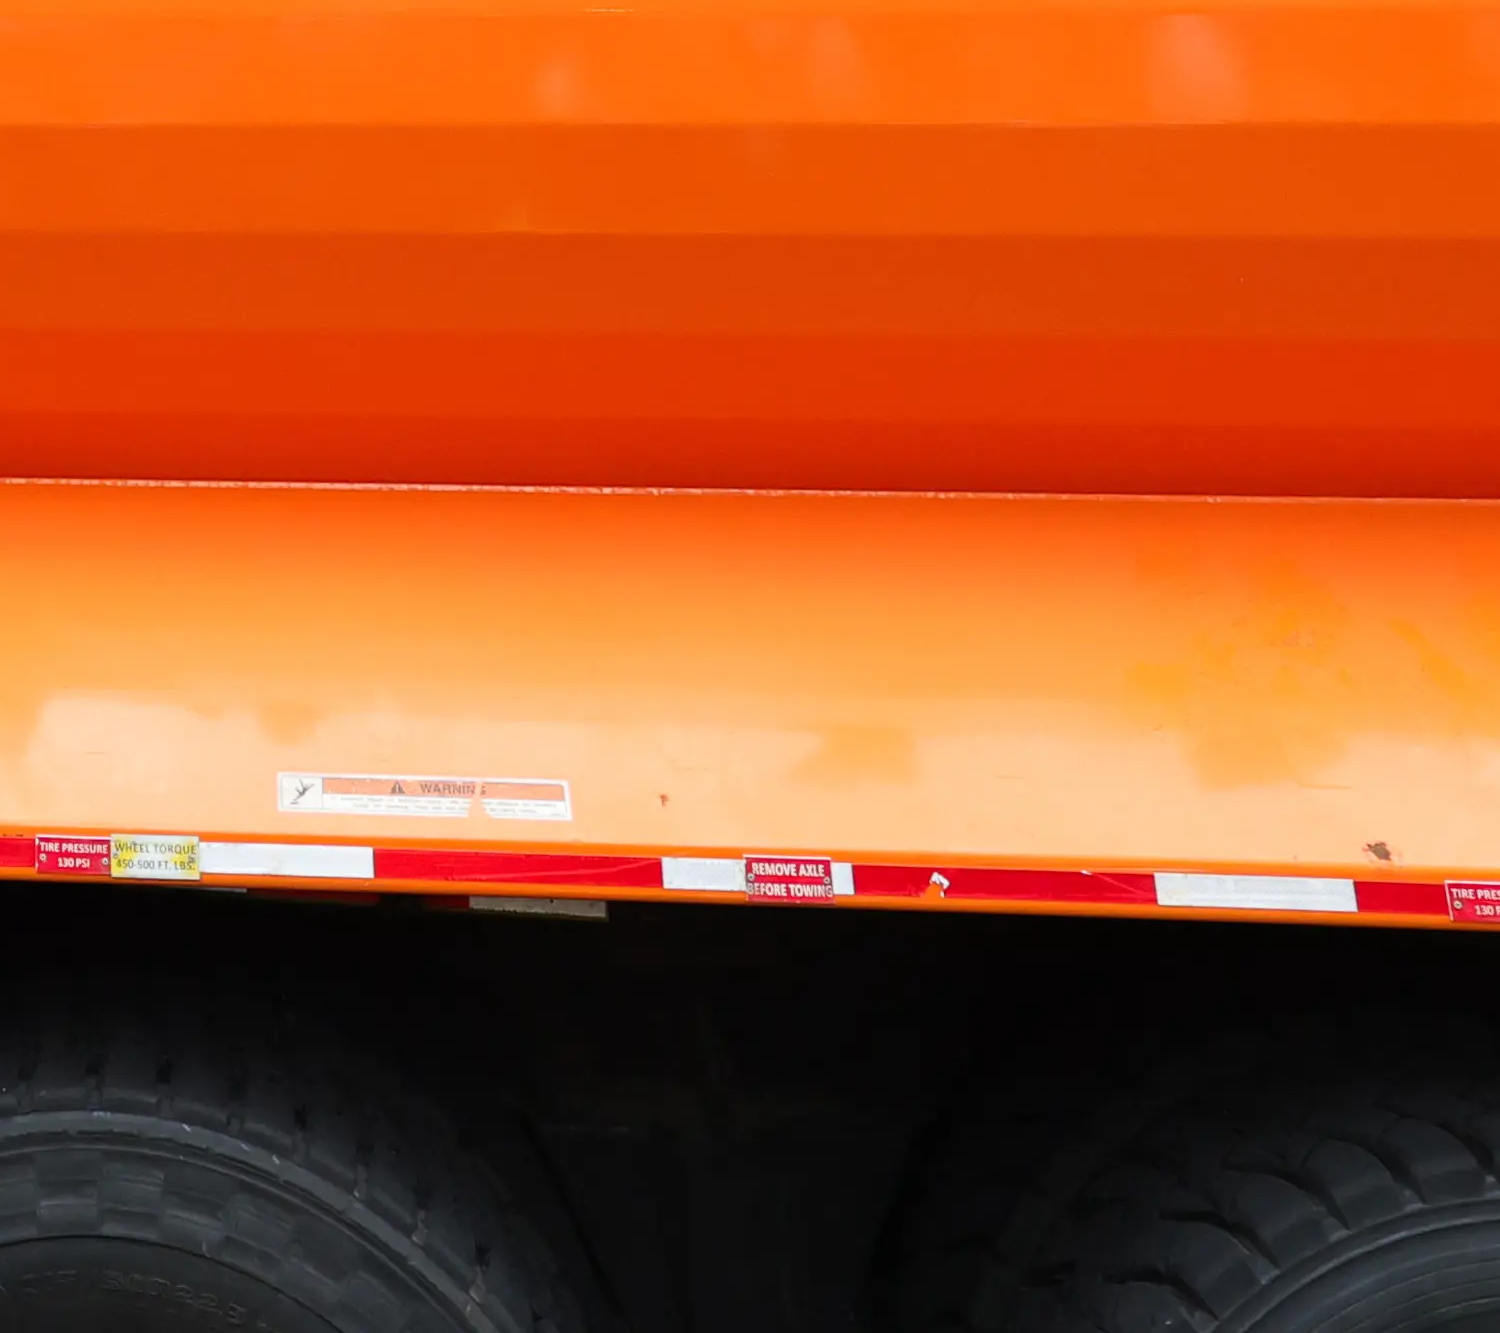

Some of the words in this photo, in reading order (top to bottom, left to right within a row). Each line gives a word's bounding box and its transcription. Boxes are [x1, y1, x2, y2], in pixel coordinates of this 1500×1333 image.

[40, 842, 59, 854] TIRE
[62, 842, 108, 854] PRESSURE
[115, 842, 150, 854] WHEEL
[154, 842, 197, 854] TORQUE
[58, 857, 75, 868] 130
[76, 857, 90, 868] PSI
[752, 862, 797, 877] REMOVE
[799, 862, 824, 877] AXLE
[748, 883, 787, 897] BEFORE
[789, 883, 832, 897] TOWING
[1451, 888, 1475, 901] TIRE
[1474, 905, 1494, 916] 130
